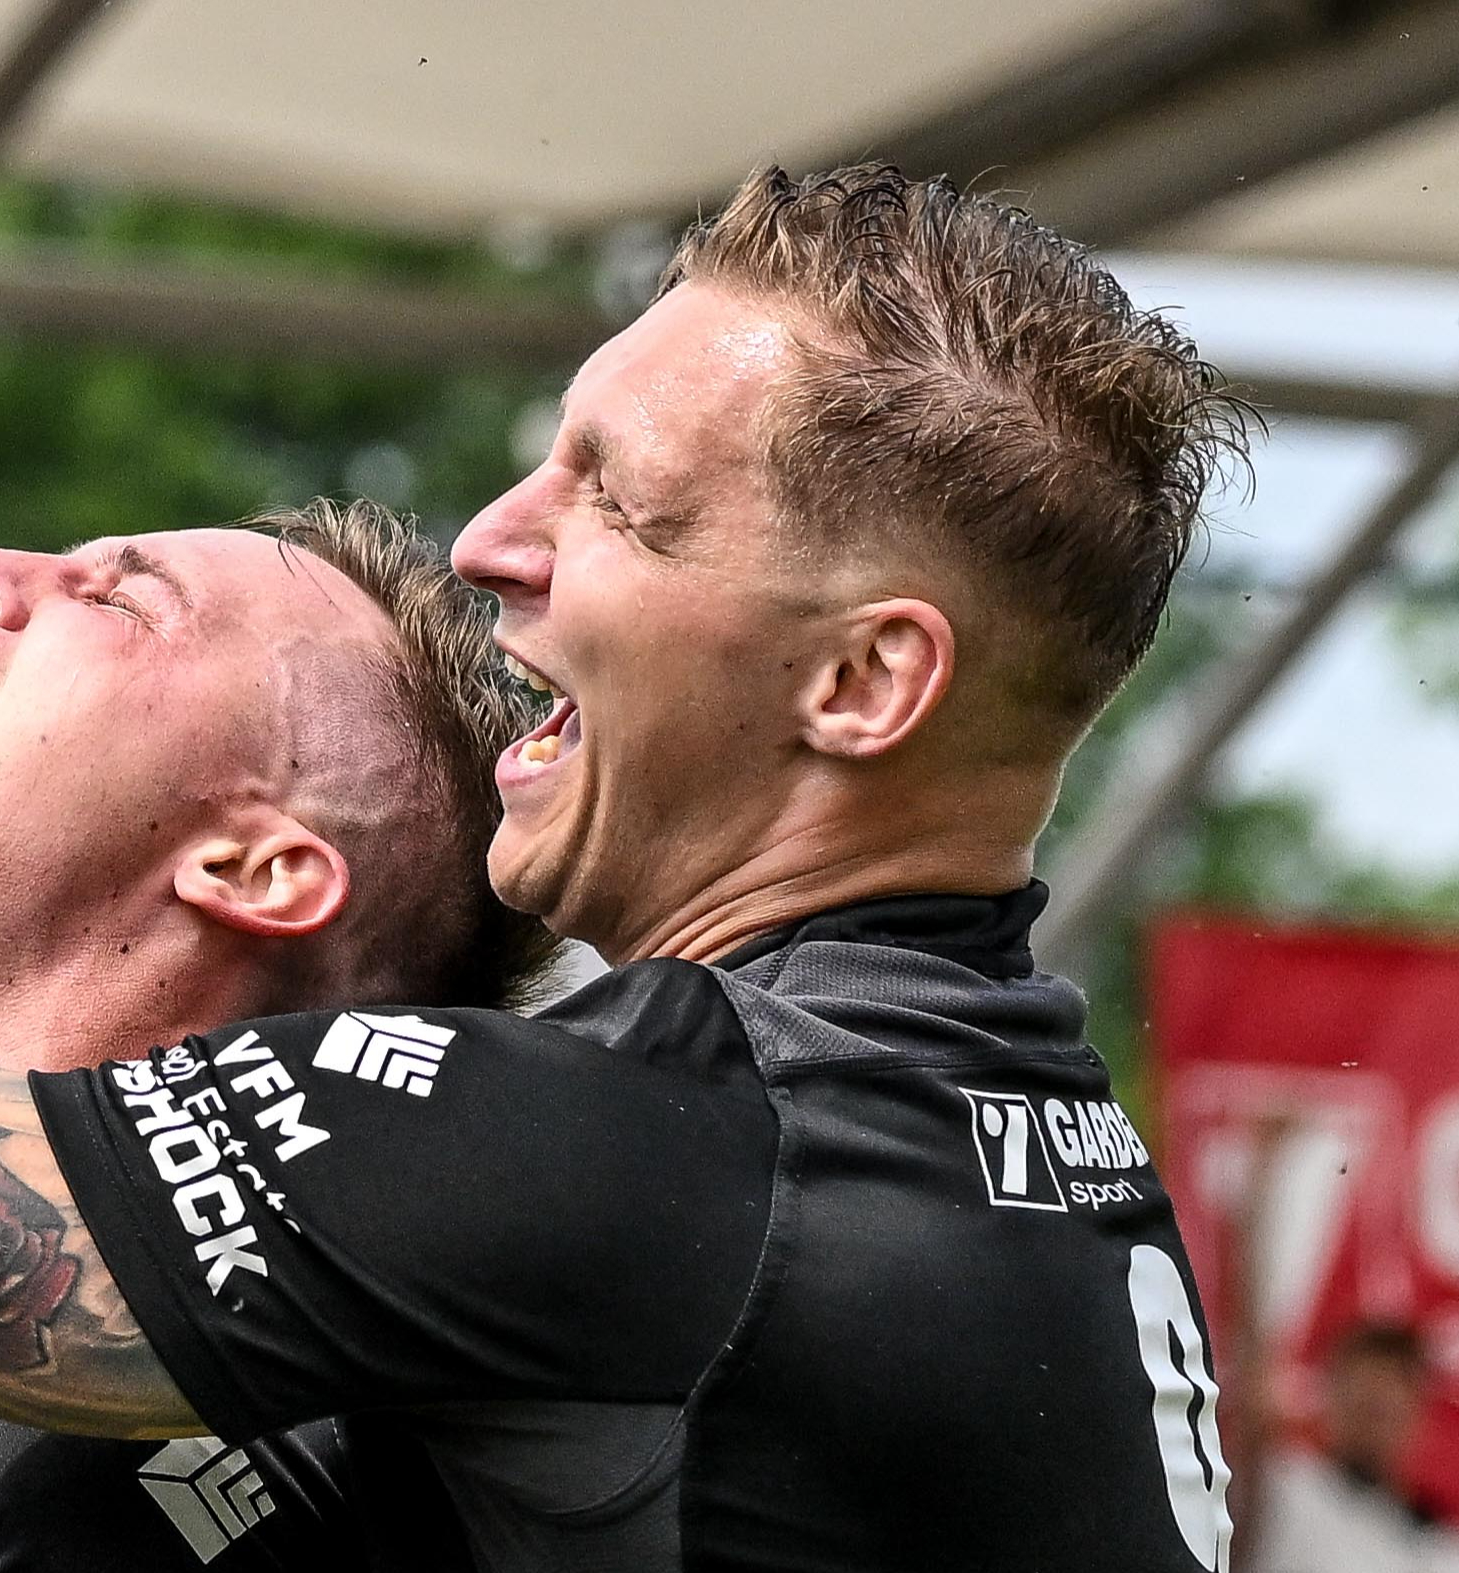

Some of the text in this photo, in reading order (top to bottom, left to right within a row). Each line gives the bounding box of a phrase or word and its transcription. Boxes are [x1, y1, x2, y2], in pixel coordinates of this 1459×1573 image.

[214, 1030, 331, 1163] VFM
[111, 1060, 269, 1297] SHOCK
[1069, 1178, 1144, 1211] sport
